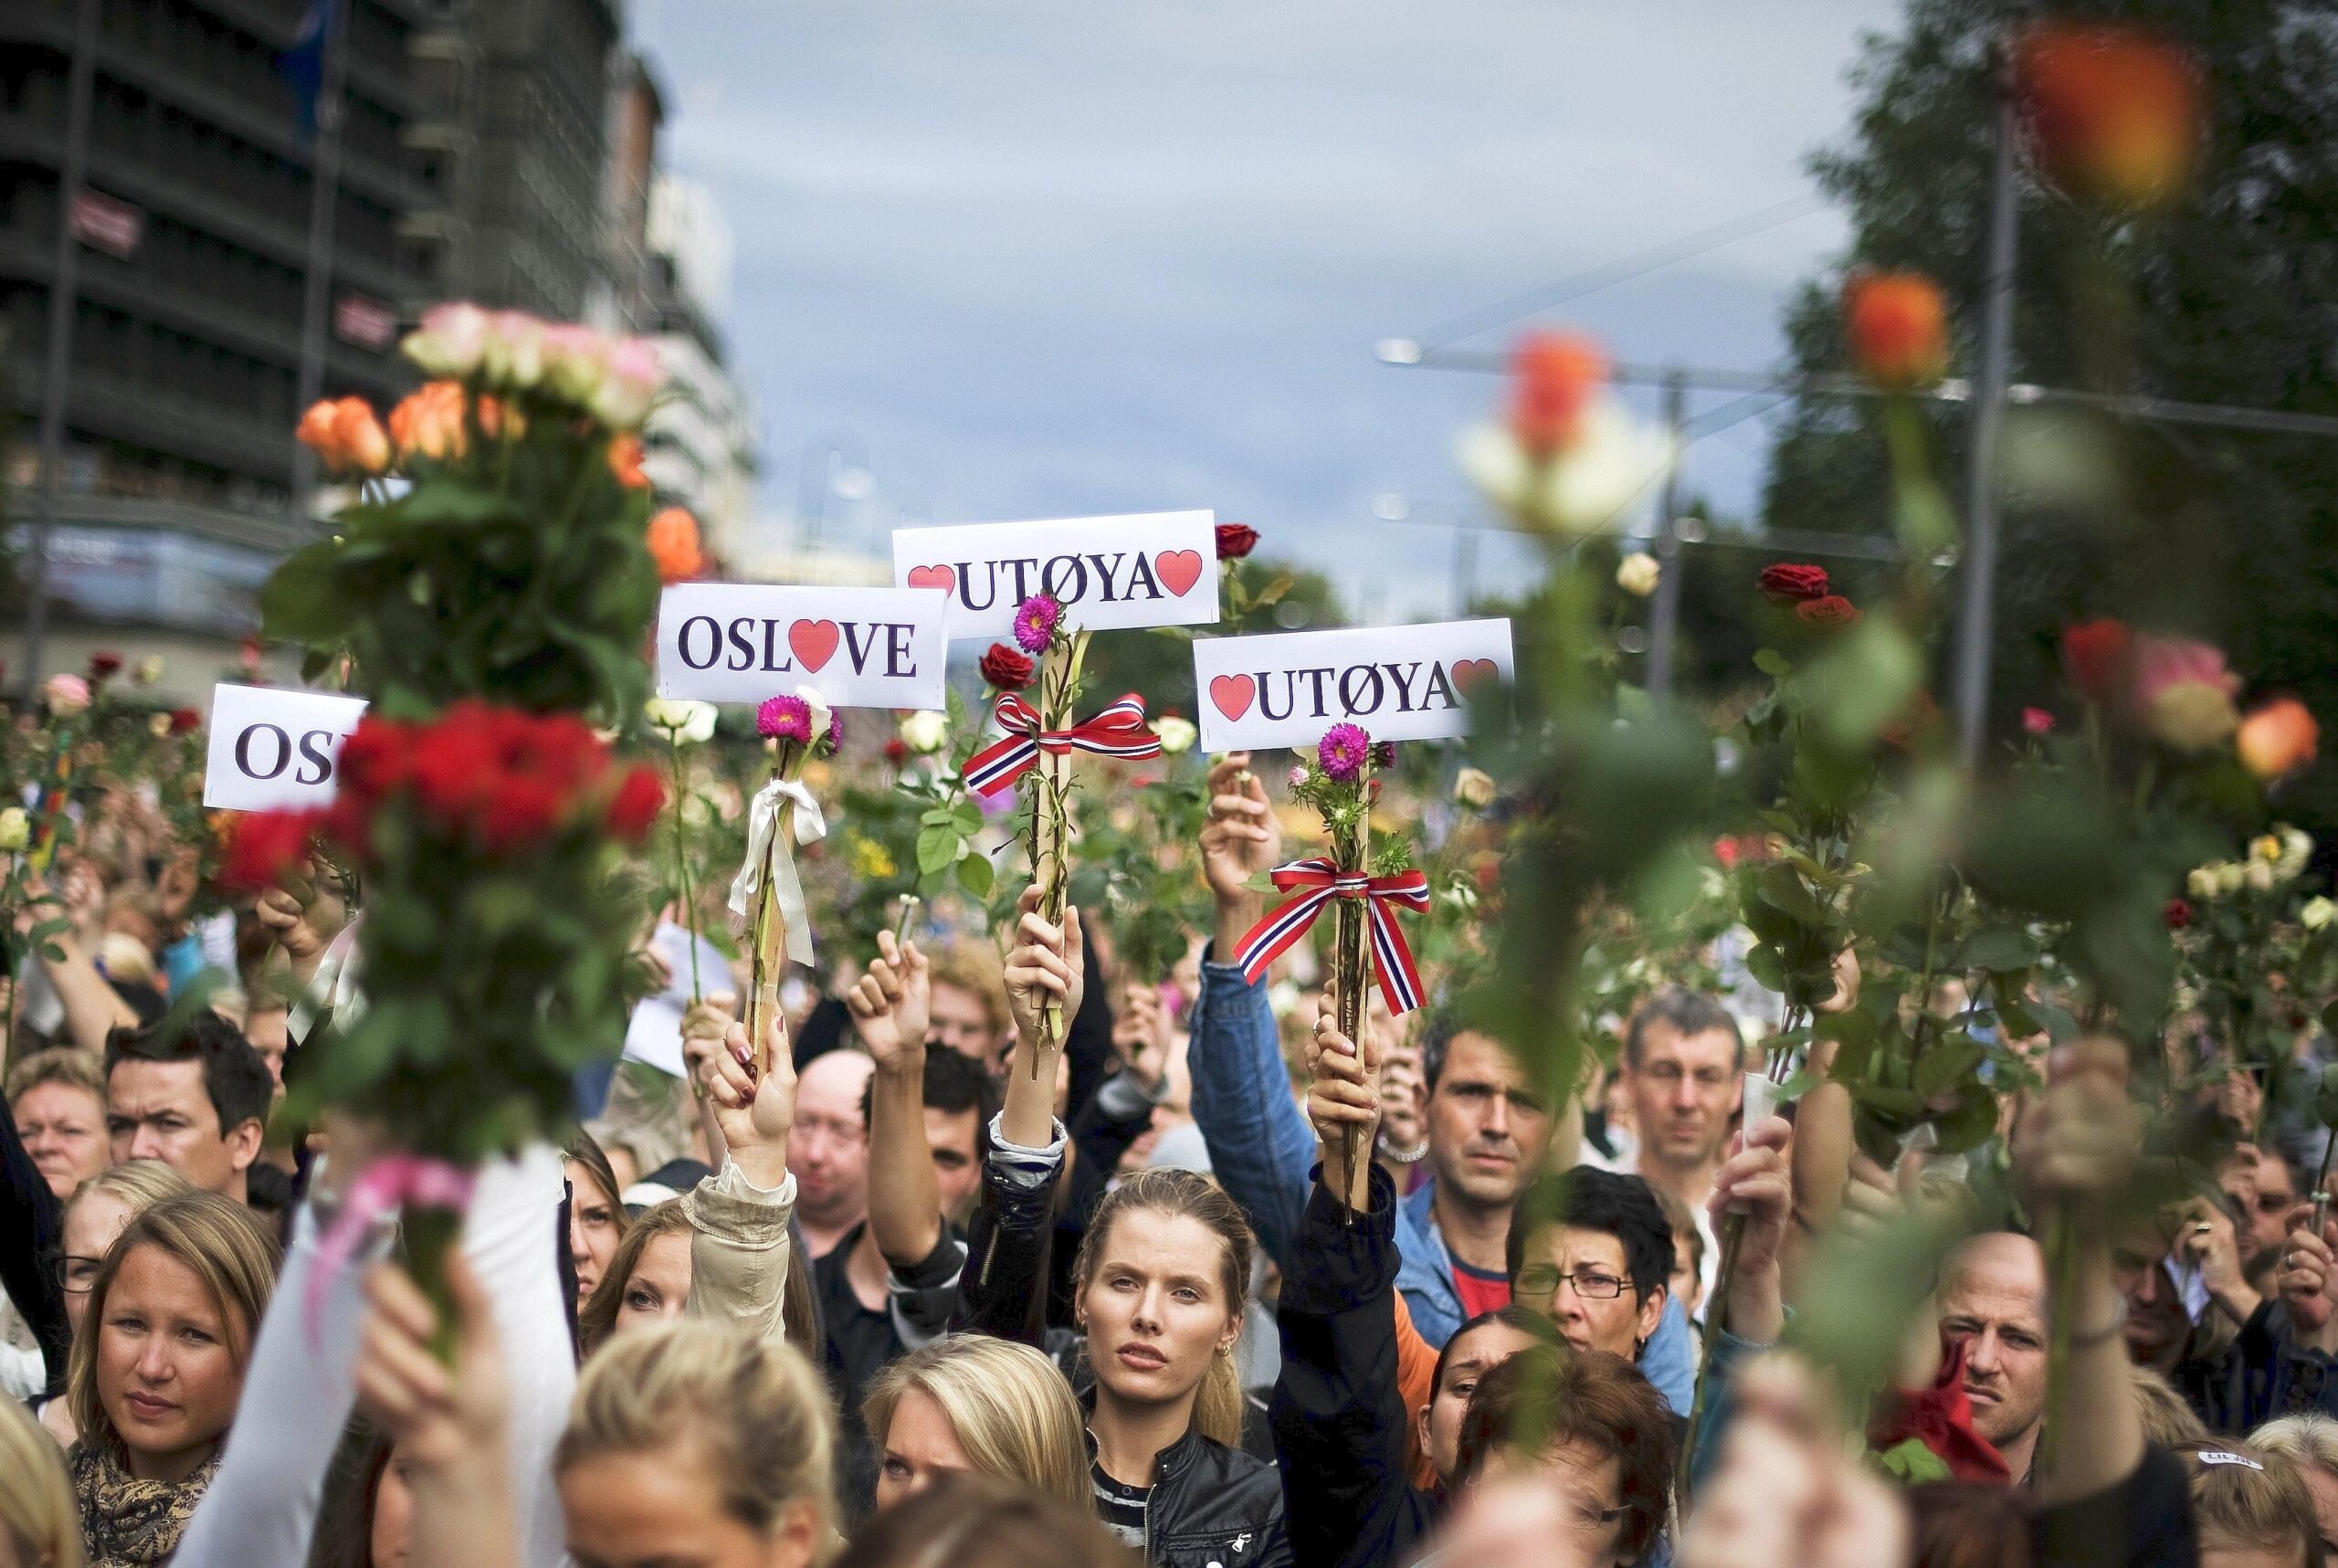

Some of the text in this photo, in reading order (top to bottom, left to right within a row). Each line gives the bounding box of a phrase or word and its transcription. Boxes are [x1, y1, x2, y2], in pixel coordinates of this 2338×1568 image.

[953, 552, 1164, 611] UTØYA
[1253, 661, 1461, 721] UTØYA
[235, 723, 354, 785] OS
